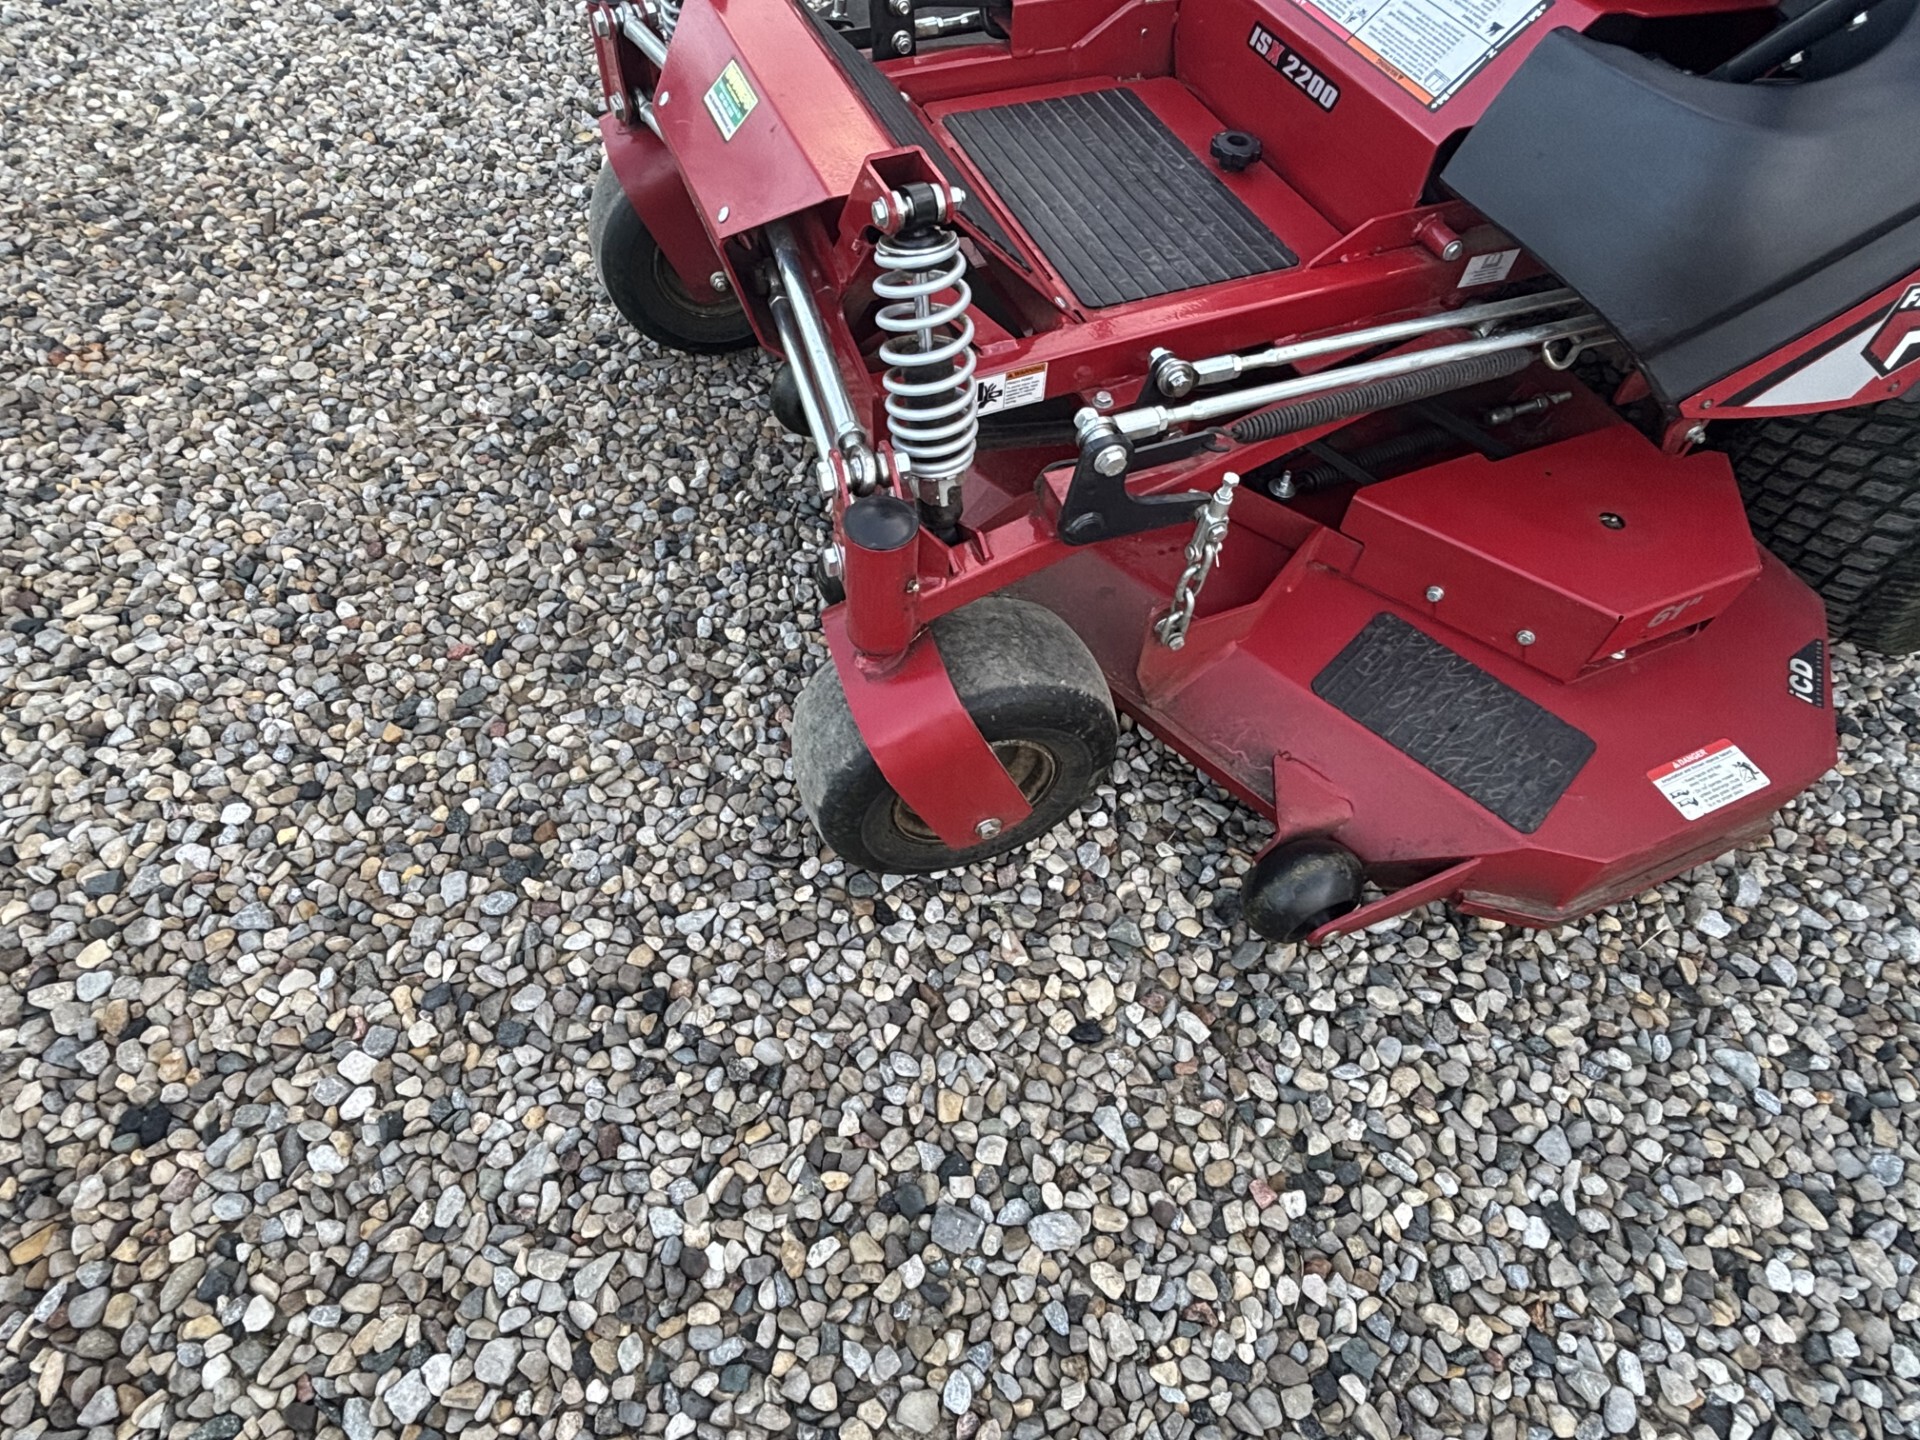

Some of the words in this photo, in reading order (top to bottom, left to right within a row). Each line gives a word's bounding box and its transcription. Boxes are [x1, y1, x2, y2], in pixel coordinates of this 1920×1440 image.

[1249, 25, 1285, 66] ISX
[1282, 53, 1338, 110] 2200
[1789, 658, 1814, 704] iCD
[1677, 748, 1708, 767] DANGER
